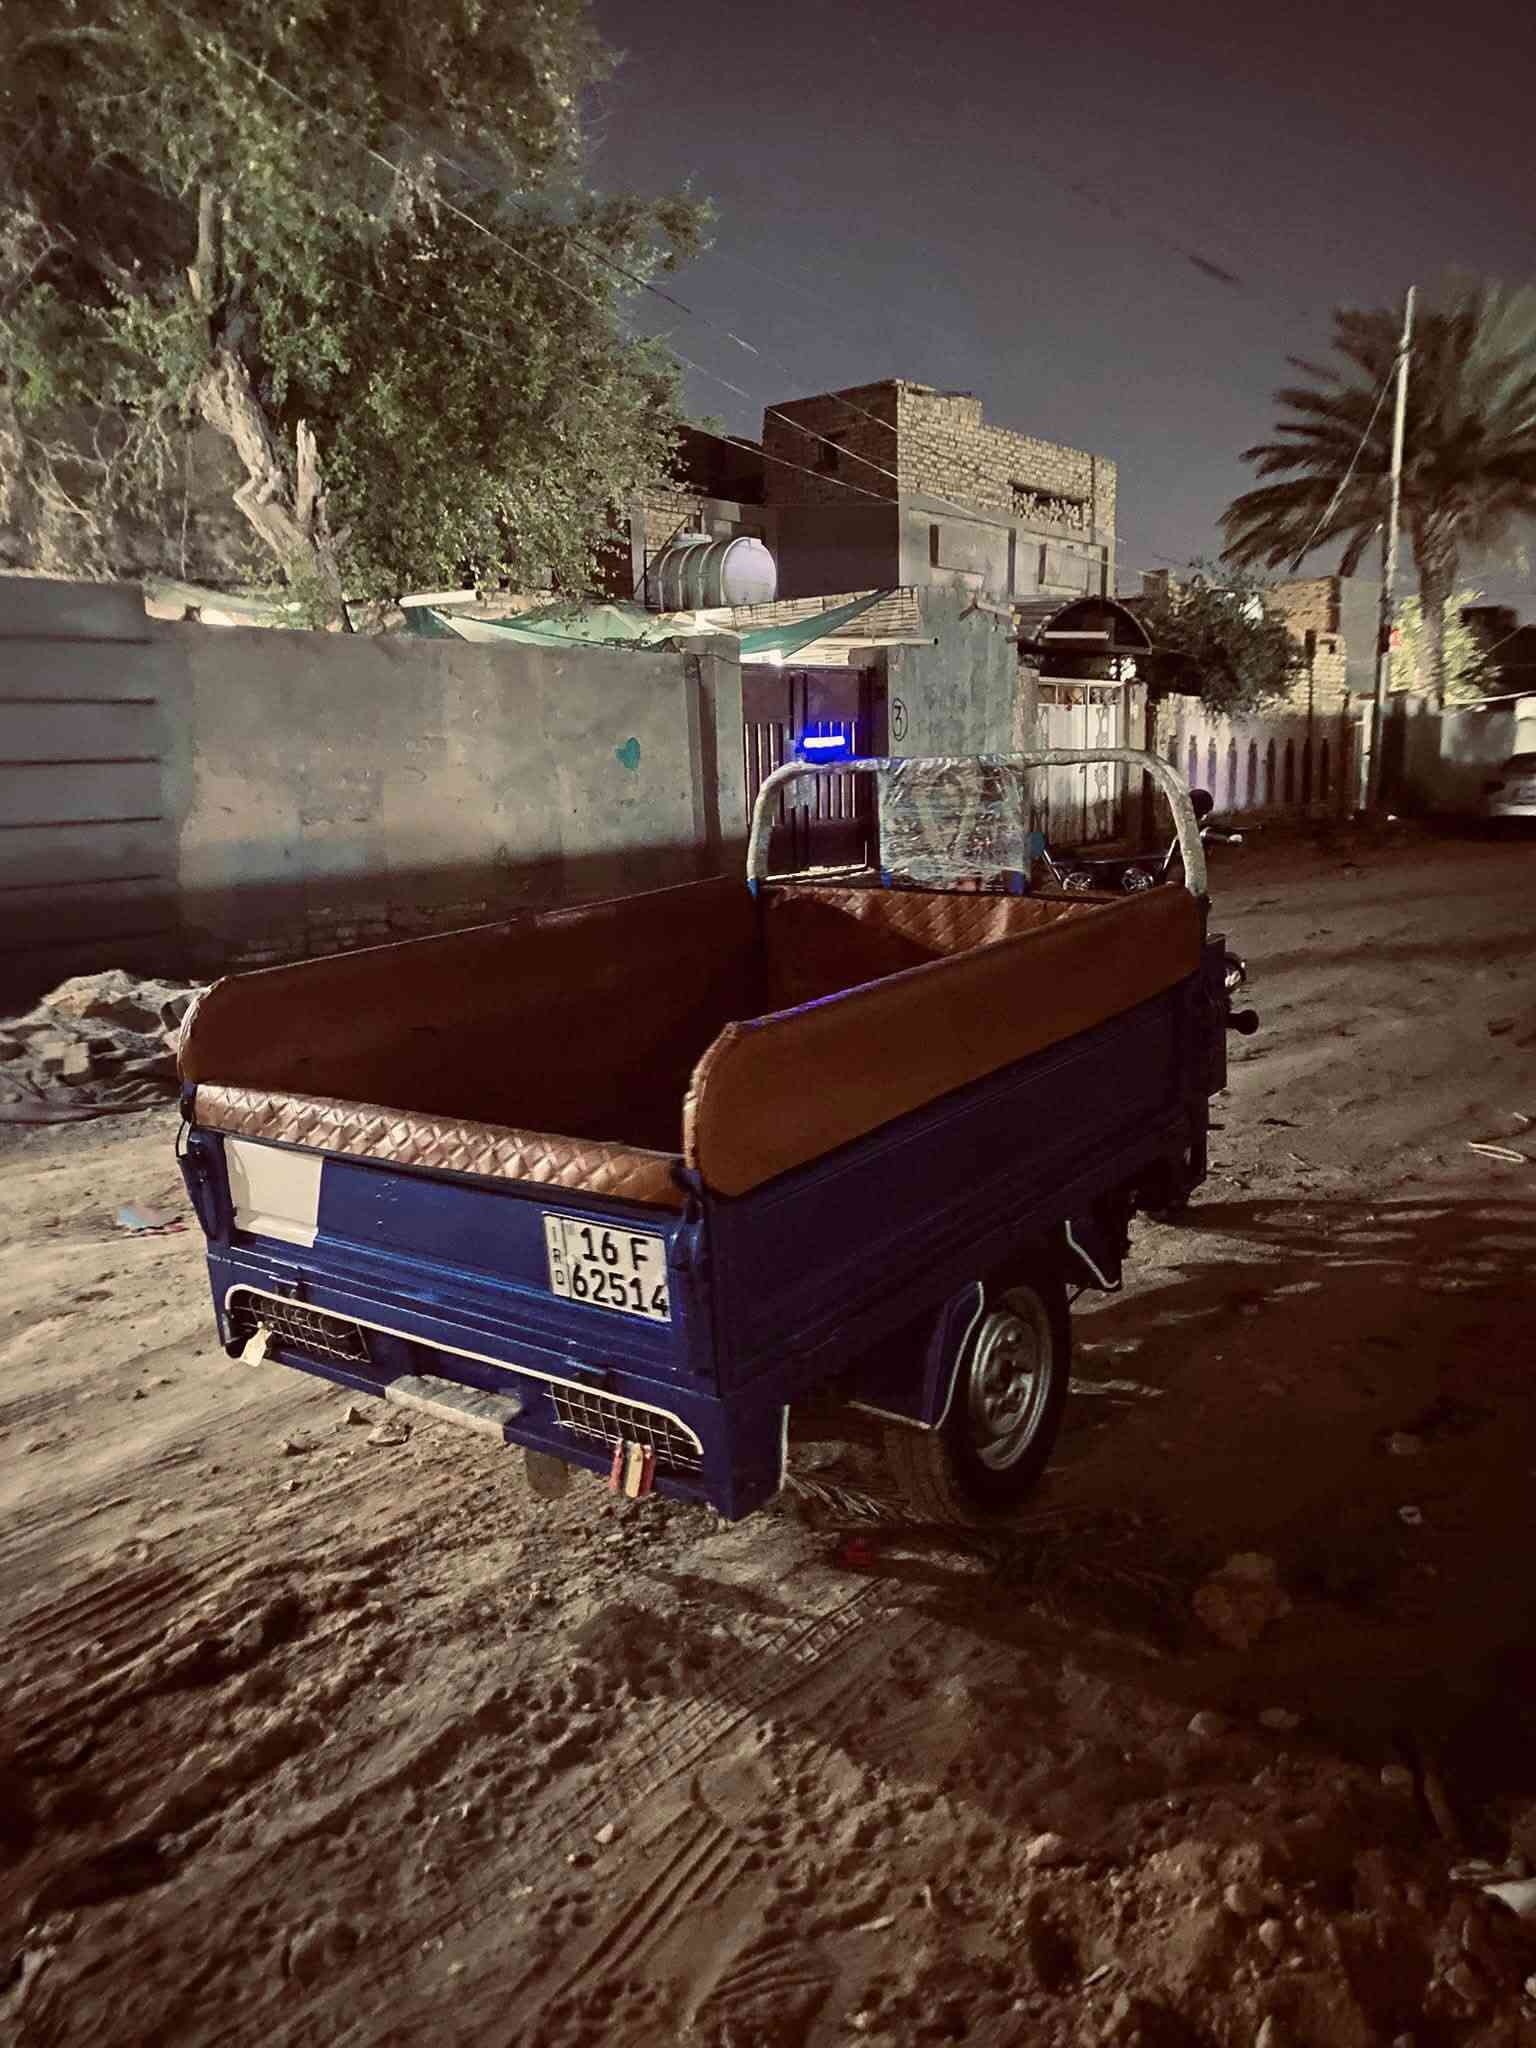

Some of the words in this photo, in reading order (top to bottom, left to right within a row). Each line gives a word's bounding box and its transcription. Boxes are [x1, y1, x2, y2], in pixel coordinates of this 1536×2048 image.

[580, 1227, 618, 1265] 16
[630, 1237, 648, 1271] F
[573, 1263, 668, 1317] 62514
